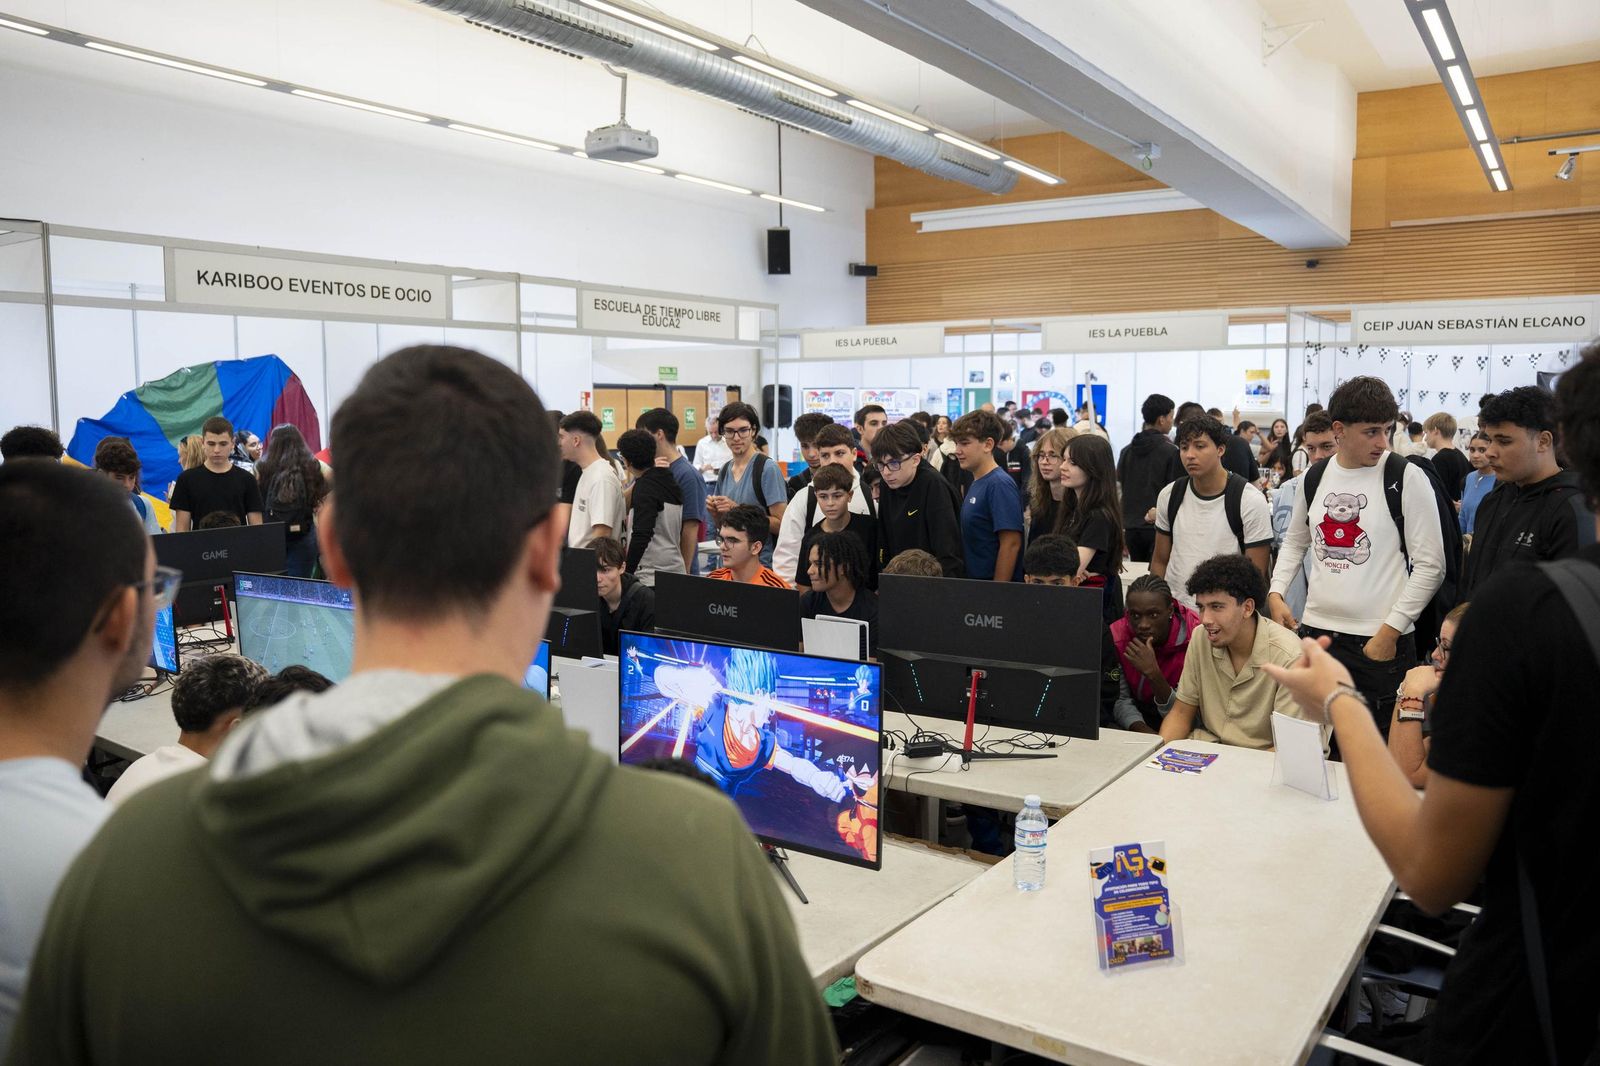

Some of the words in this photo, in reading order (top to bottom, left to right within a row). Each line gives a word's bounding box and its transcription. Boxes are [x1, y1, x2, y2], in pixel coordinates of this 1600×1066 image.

[197, 269, 283, 291] KARIBOO
[289, 278, 366, 297] EVENTOS
[371, 285, 391, 299] DE
[394, 287, 432, 303] OCIO
[594, 298, 641, 314] ESCUELA
[644, 304, 657, 316] DE
[659, 306, 694, 320] TIEMPO
[696, 310, 721, 323] LIBRE
[642, 314, 681, 329] EDUCA2
[1363, 321, 1394, 332] CEIP
[1397, 319, 1434, 331] JUAN
[1437, 315, 1518, 330] SEBASTIÁN
[1522, 315, 1586, 328] ELCANO
[1088, 328, 1105, 338] IES
[1108, 328, 1121, 338] LA
[1124, 326, 1168, 337] PUEBLA
[835, 338, 848, 347] IES
[850, 338, 861, 347] LA
[863, 336, 897, 346] PUEBLA
[201, 549, 229, 561] GAME
[1324, 562, 1350, 570] MONCLER
[708, 602, 738, 618] GAME
[964, 613, 1003, 629] GAME
[628, 665, 634, 675] 2
[861, 700, 869, 711] 0
